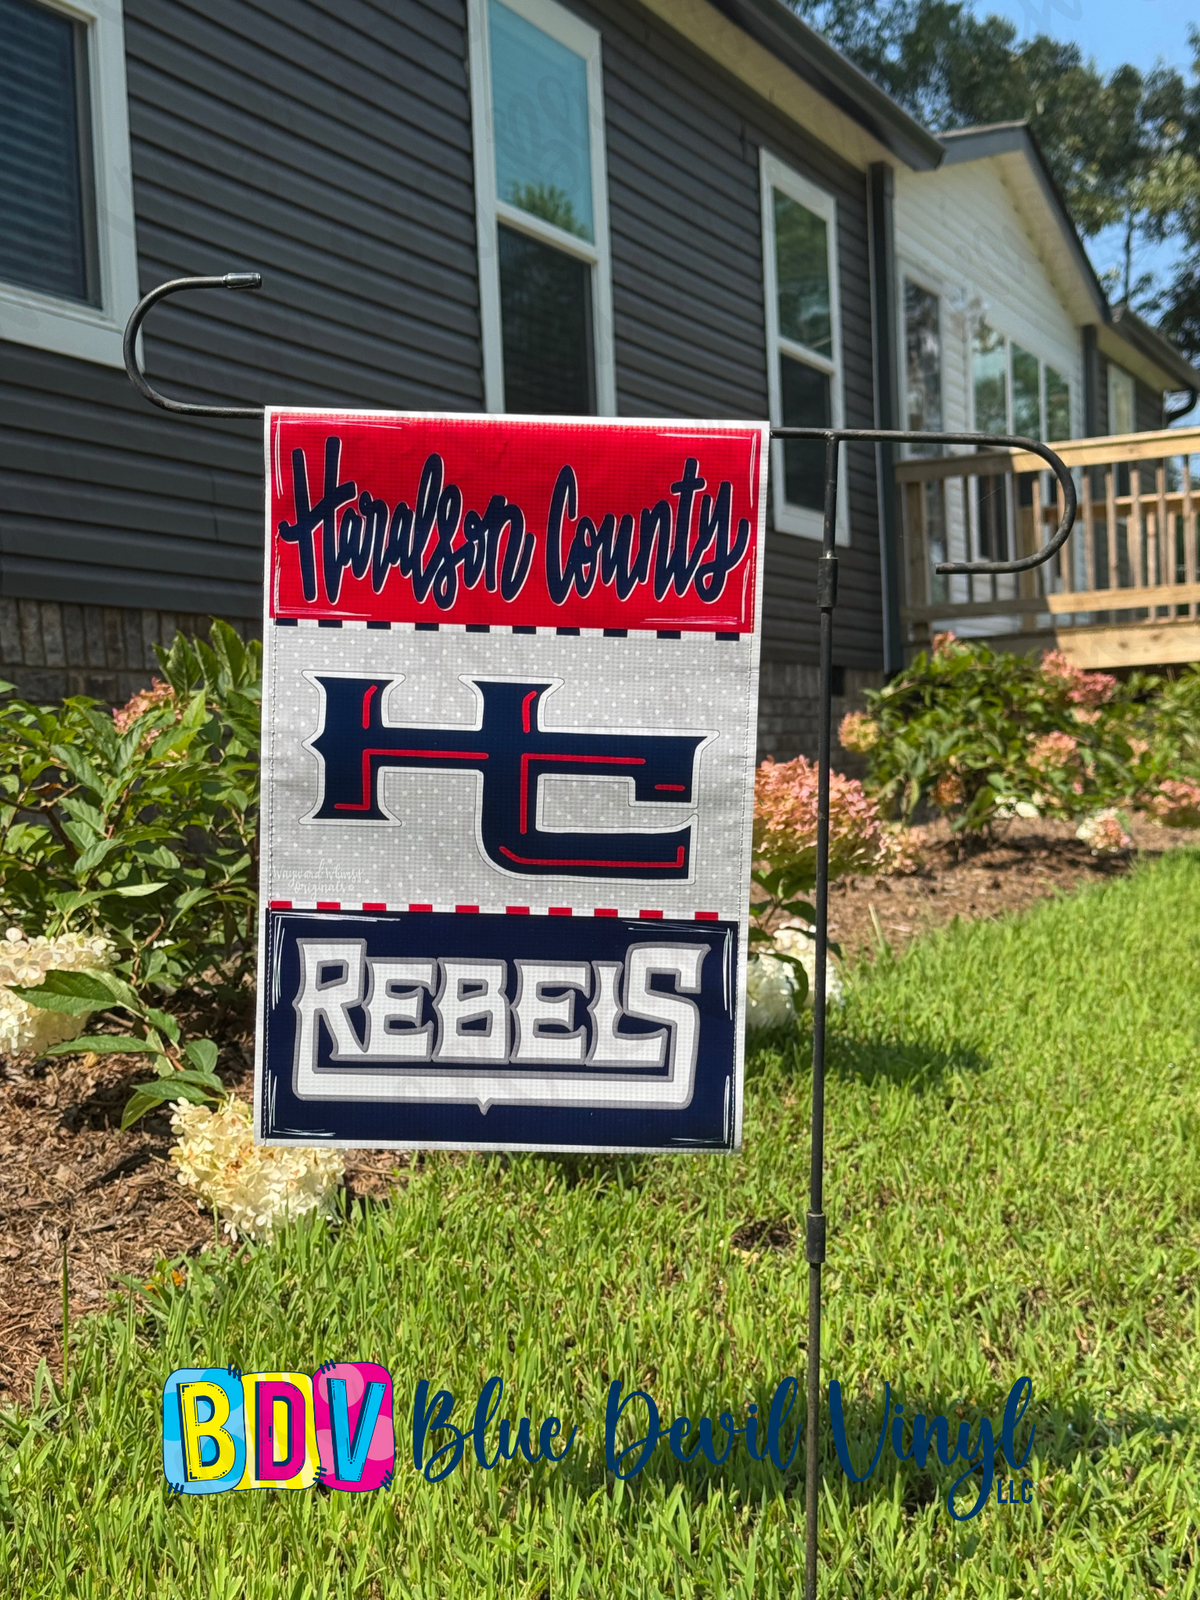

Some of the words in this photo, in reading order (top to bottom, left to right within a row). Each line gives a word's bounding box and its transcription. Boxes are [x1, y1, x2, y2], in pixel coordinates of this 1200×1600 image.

[279, 436, 536, 610] Haralson
[545, 457, 750, 605] County
[293, 938, 711, 1106] REBELS
